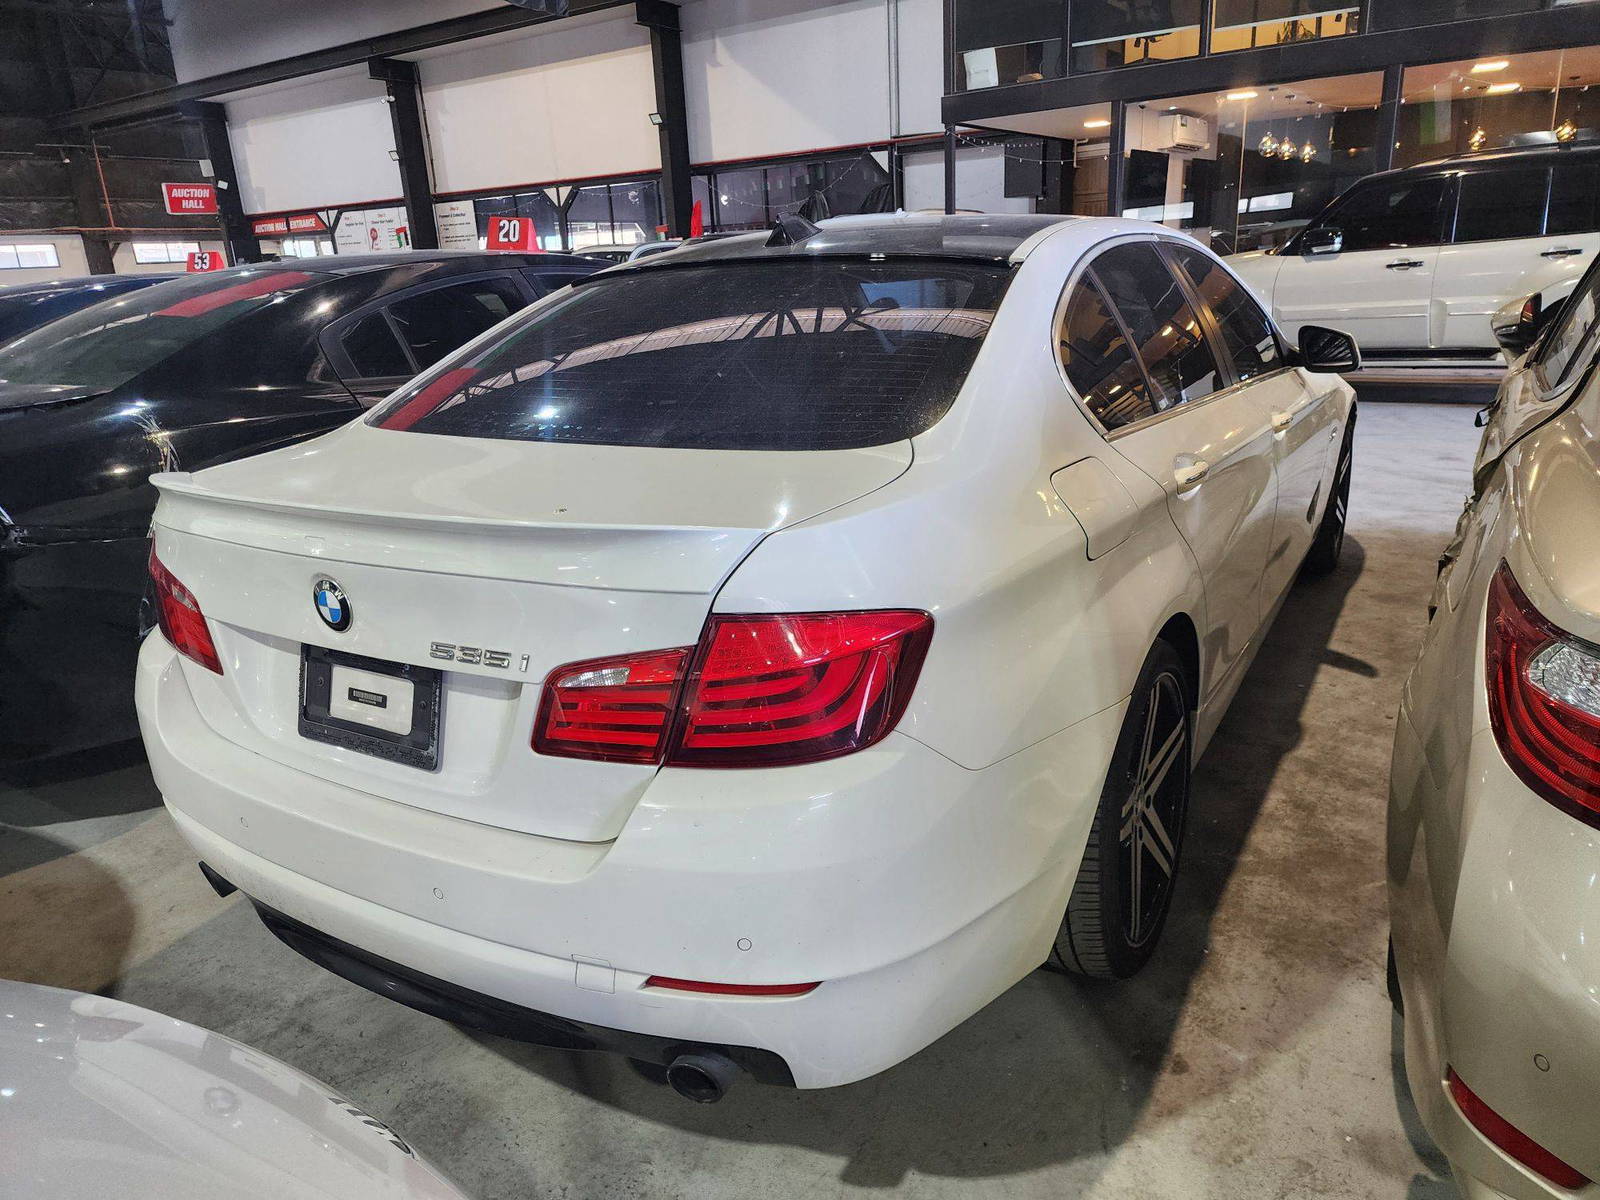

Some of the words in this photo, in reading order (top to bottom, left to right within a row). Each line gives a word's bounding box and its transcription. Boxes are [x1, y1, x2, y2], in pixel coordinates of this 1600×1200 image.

[171, 188, 210, 198] AUCTION
[182, 199, 205, 209] HALL
[255, 223, 275, 233] AUCTION
[289, 218, 316, 230] ENTRANCE
[498, 219, 520, 243] 20
[194, 252, 210, 270] 53
